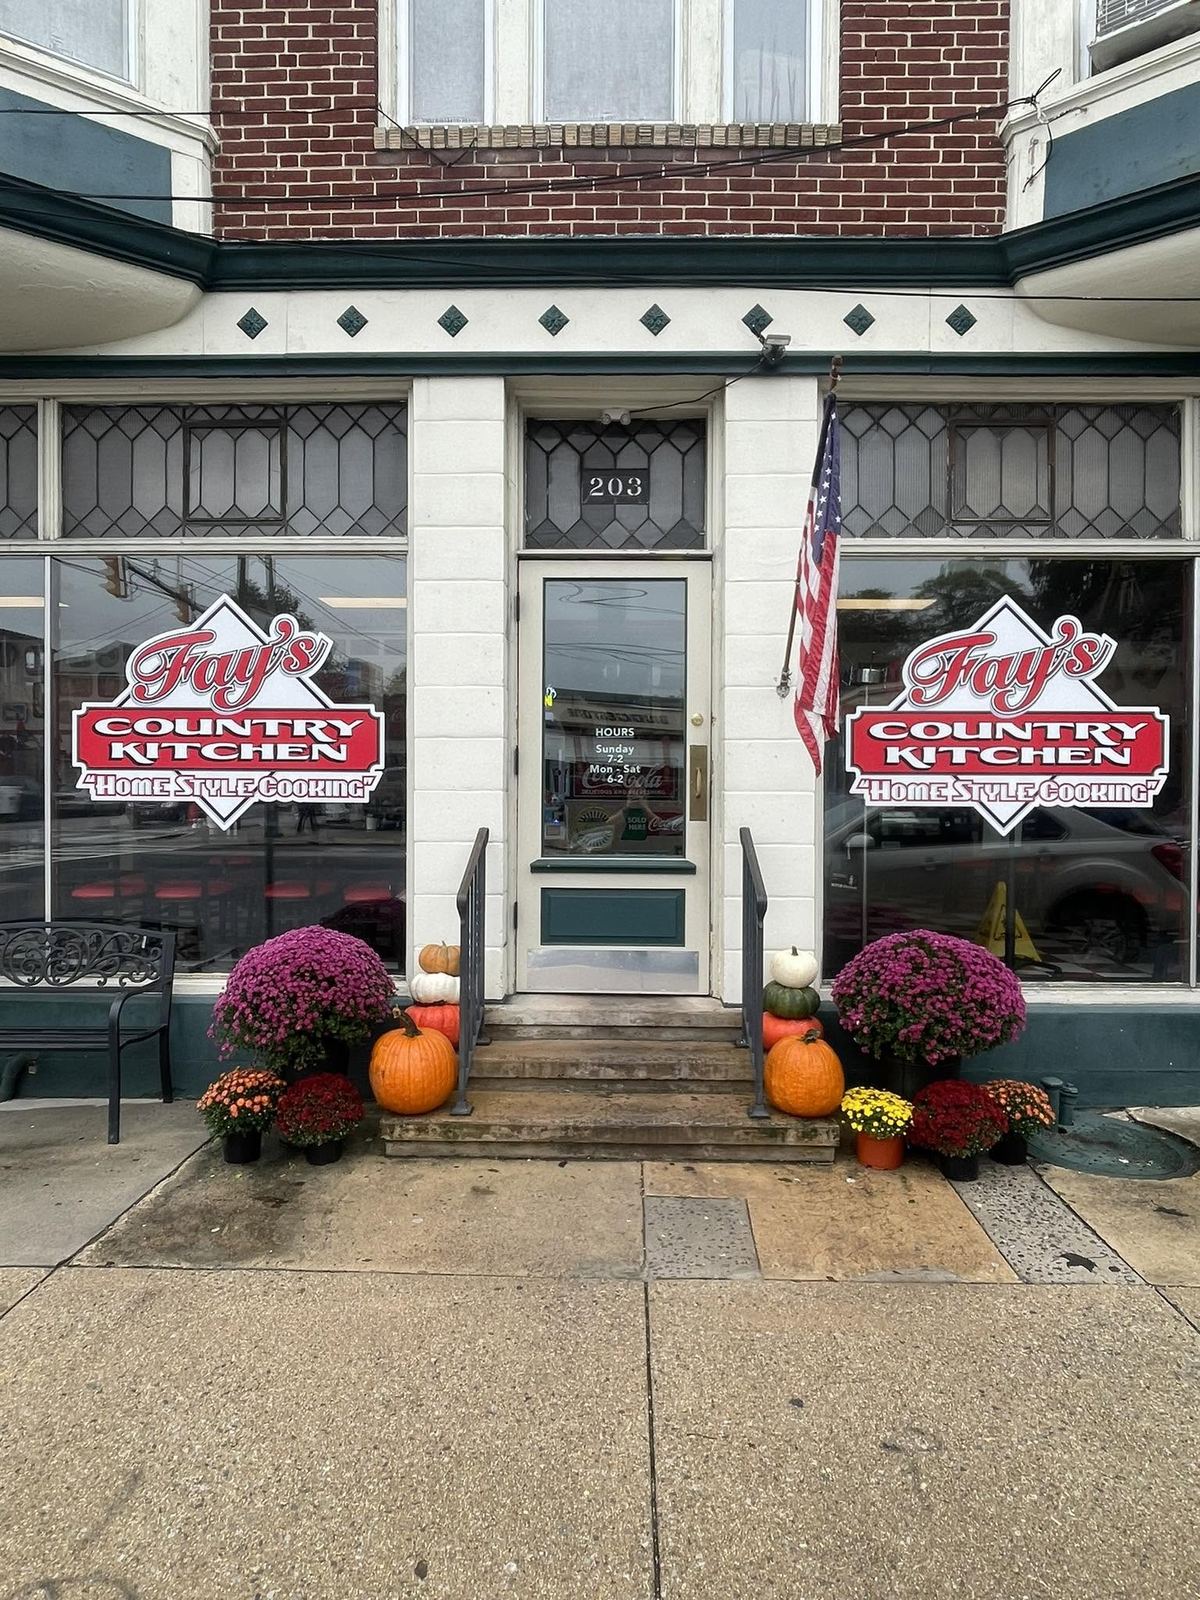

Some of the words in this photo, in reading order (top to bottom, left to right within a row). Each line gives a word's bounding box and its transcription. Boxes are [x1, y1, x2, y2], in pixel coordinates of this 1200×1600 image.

[590, 477, 642, 496] 203
[131, 616, 327, 712] Fay's
[907, 619, 1111, 715] Fay's
[93, 718, 364, 743] COUNTRY
[595, 727, 634, 737] HOURS
[867, 721, 1148, 746] COUNTRY
[109, 742, 347, 765] KITCHEN
[595, 743, 634, 756] Sunday
[607, 754, 624, 763] 7-2
[885, 746, 1131, 769] KITCHEN
[590, 764, 613, 773] Mon
[623, 764, 641, 773] Sat
[607, 774, 624, 783] 6-2
[627, 816, 647, 824] SOLD
